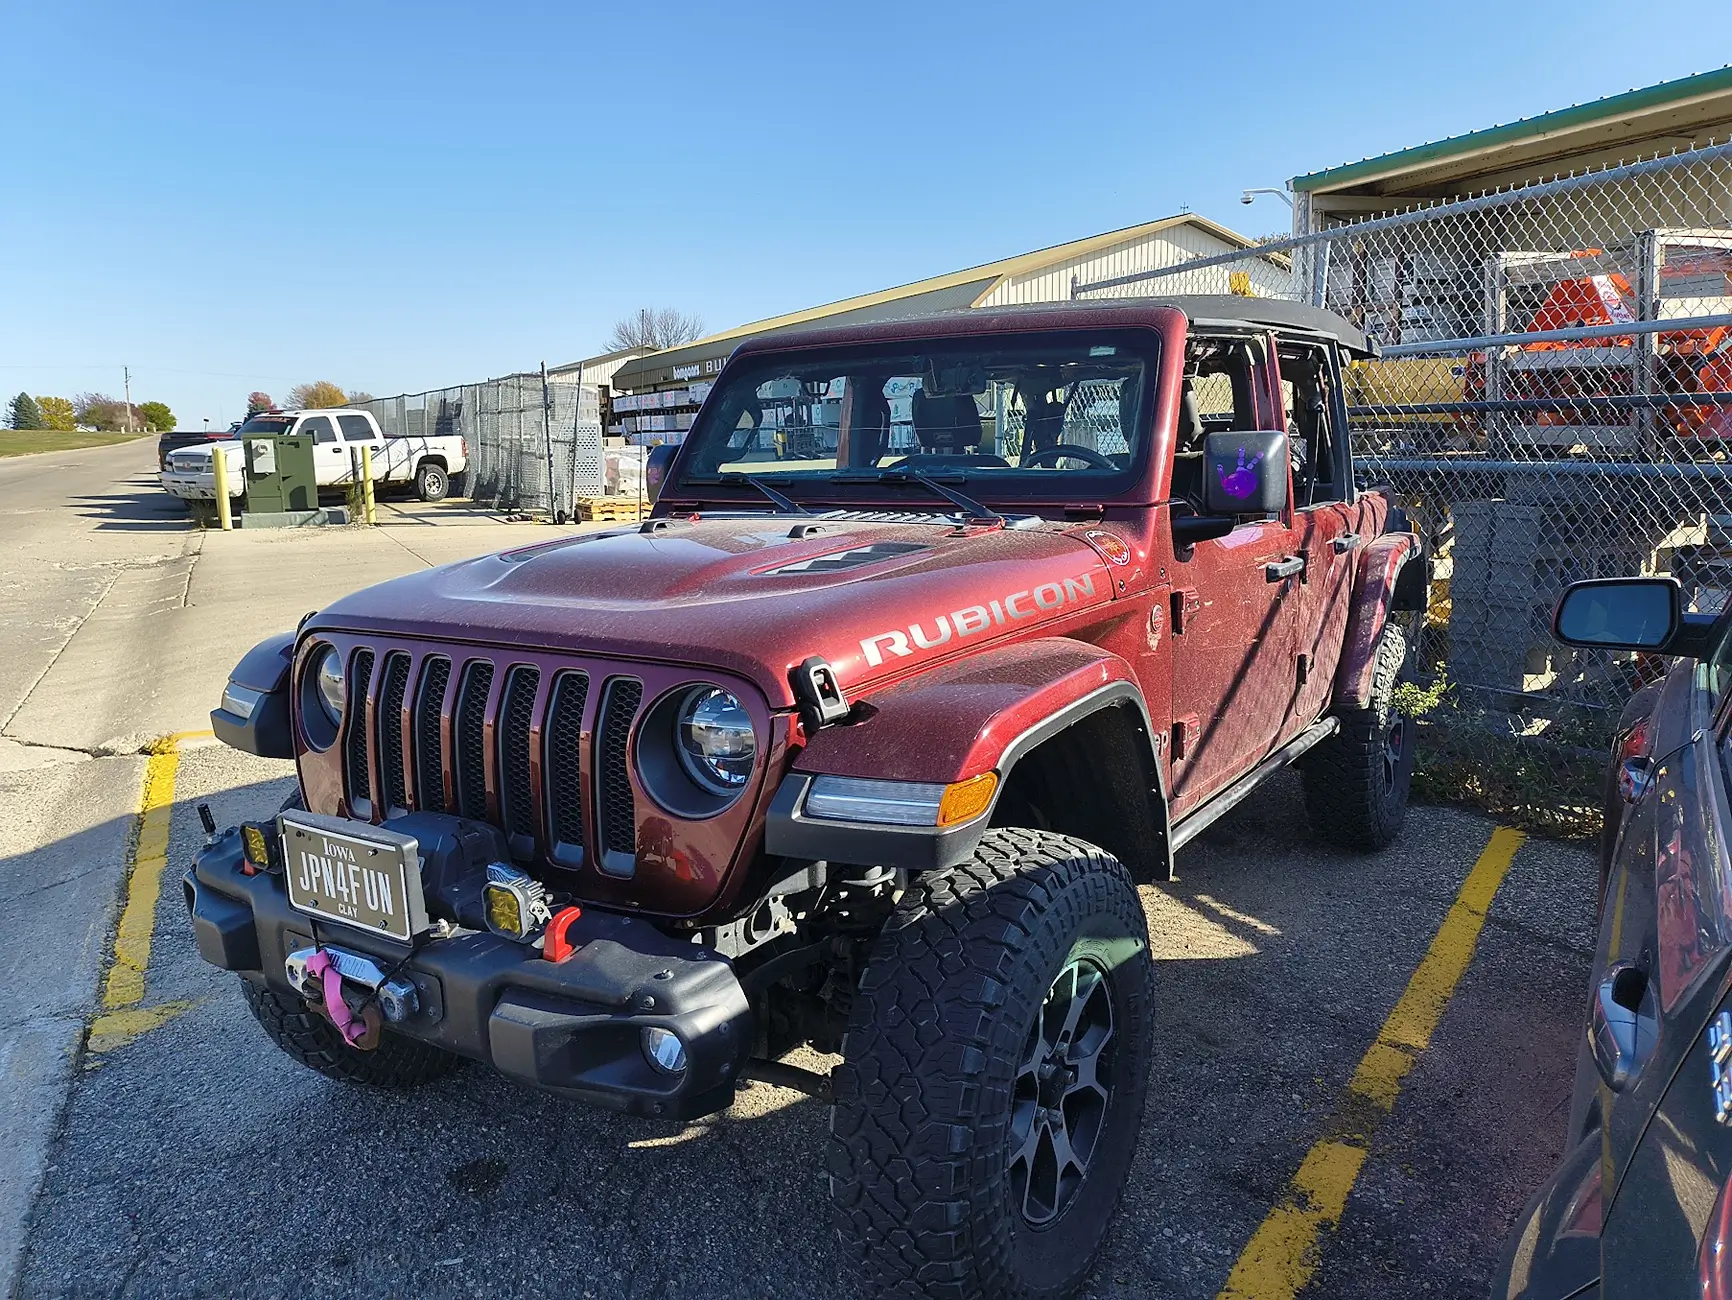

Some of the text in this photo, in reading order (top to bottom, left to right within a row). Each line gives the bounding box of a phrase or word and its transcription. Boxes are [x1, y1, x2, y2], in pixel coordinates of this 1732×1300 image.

[859, 573, 1096, 668] RUBICON
[299, 851, 394, 916] JPN4FUN
[338, 903, 358, 918] CLAY
